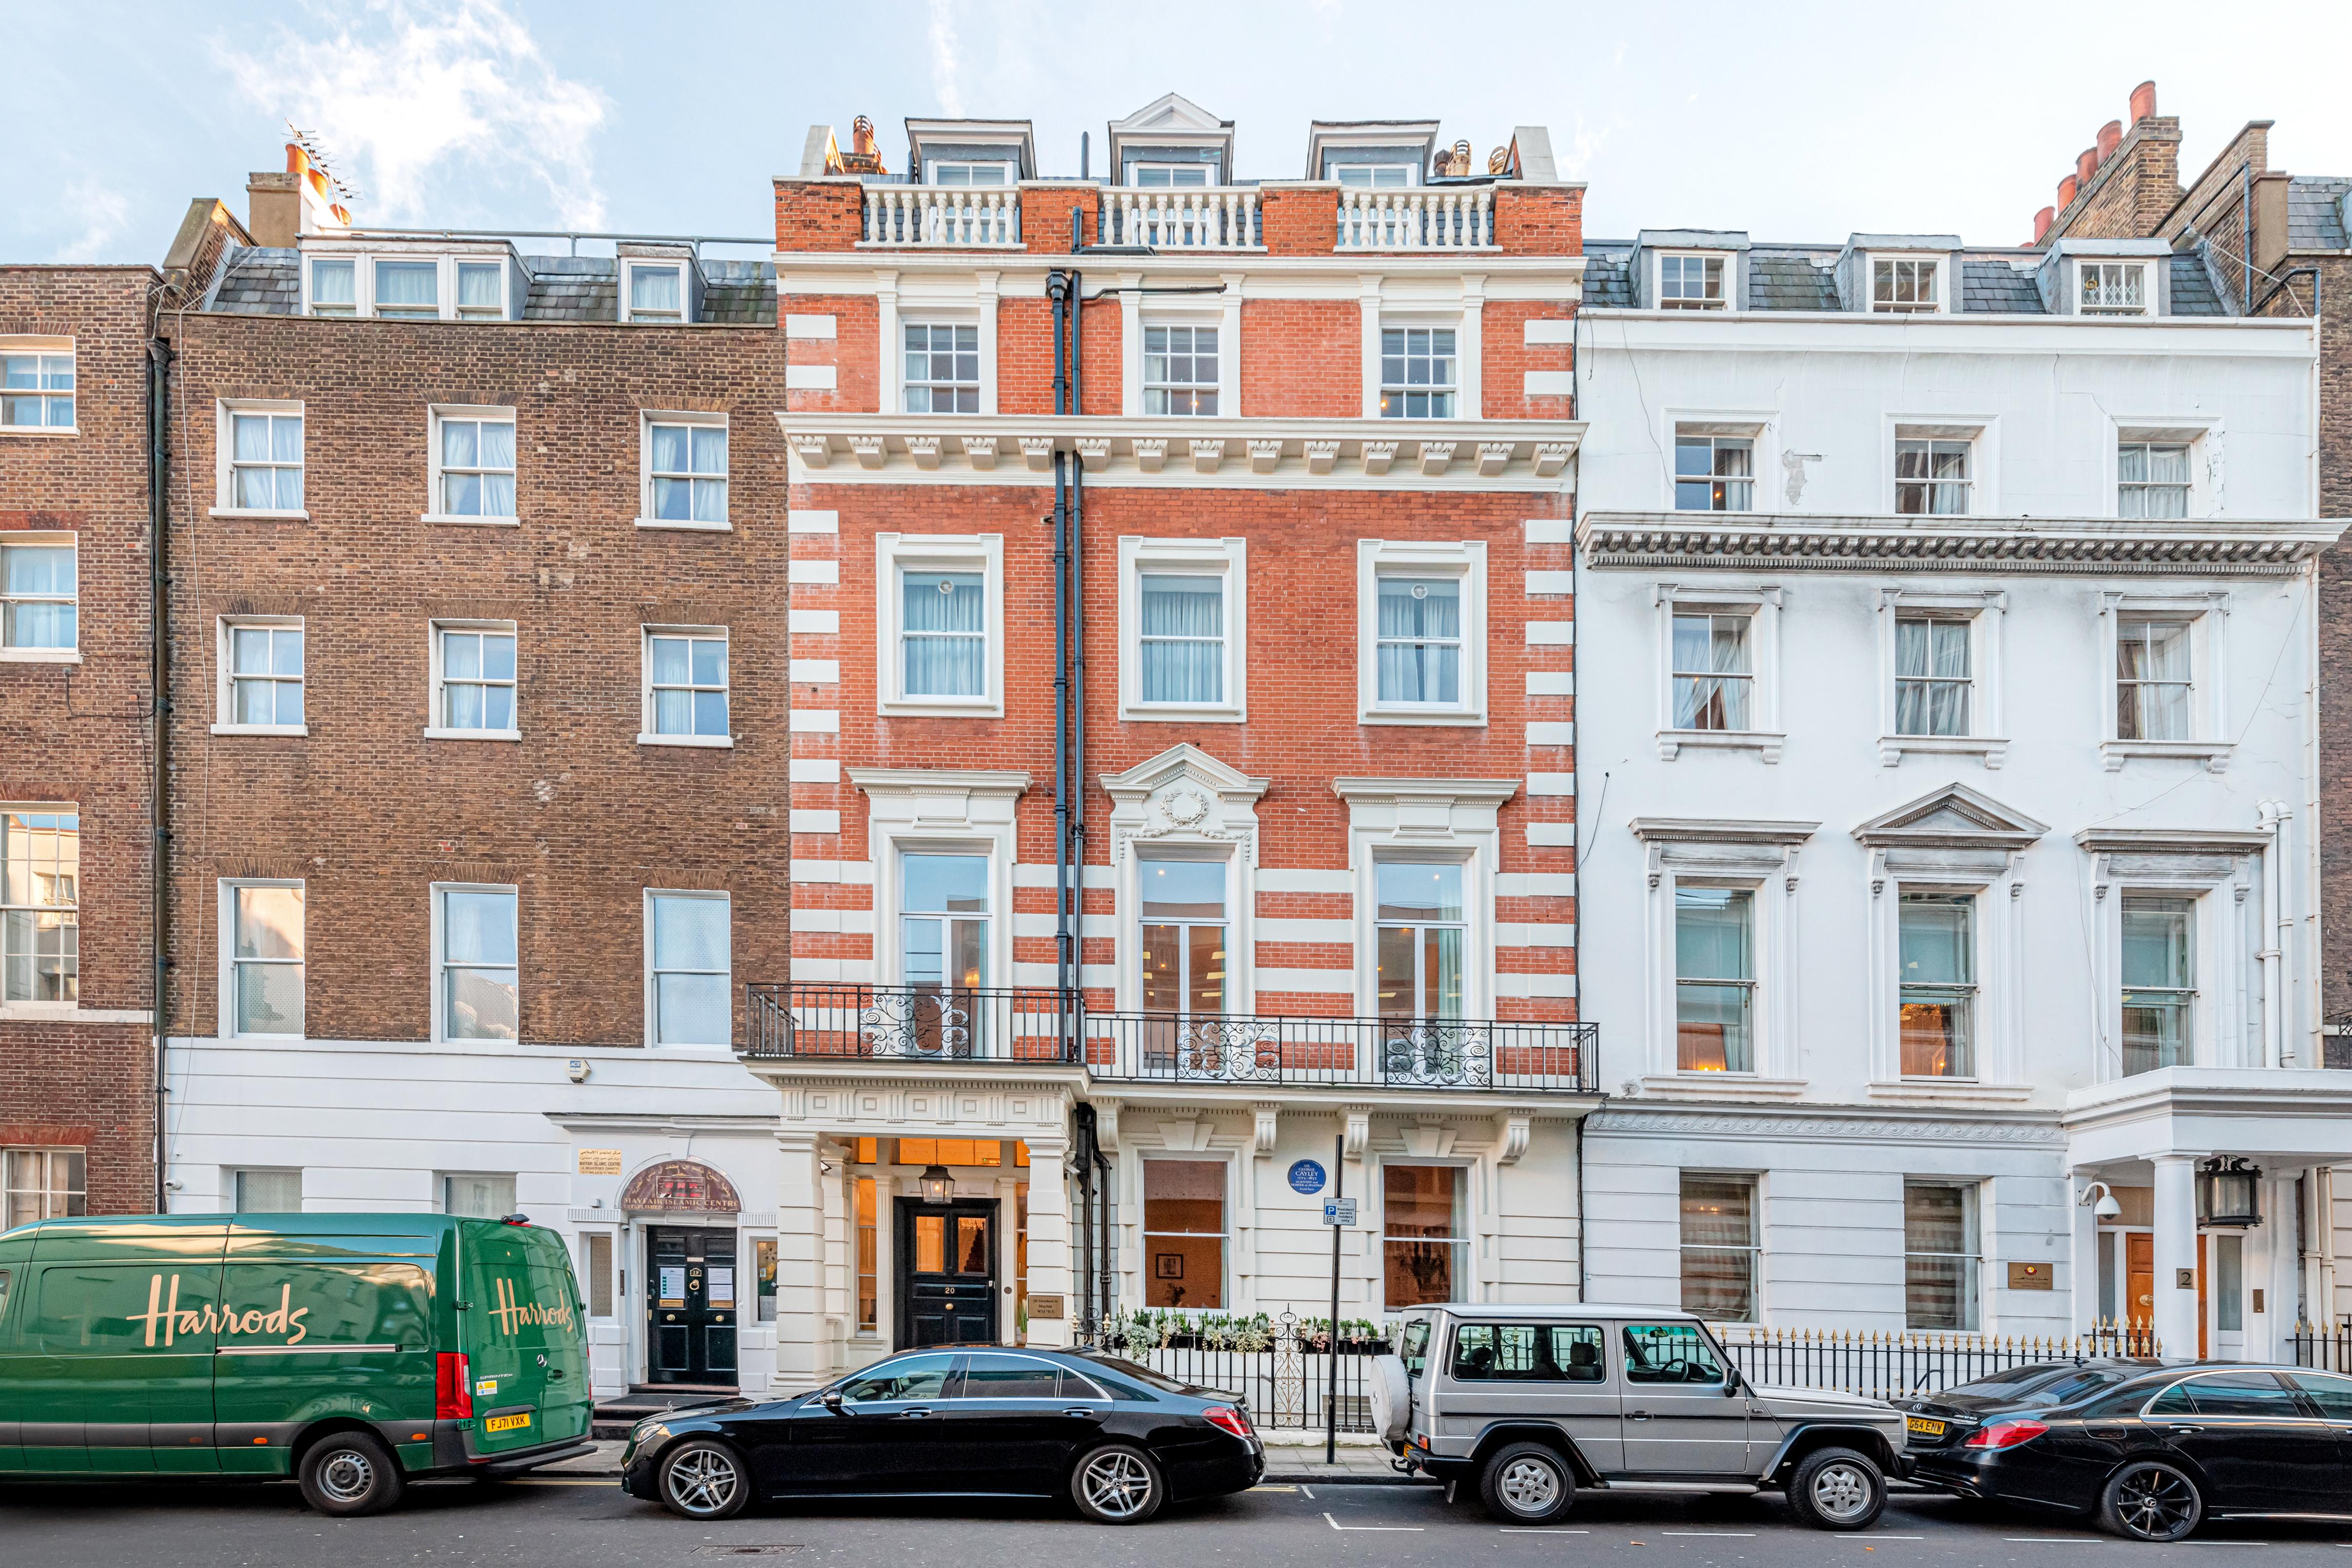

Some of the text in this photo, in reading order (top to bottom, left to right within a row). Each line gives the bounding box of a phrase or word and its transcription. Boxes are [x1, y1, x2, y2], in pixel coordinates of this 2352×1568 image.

[126, 1274, 308, 1347] Harrods
[488, 1277, 573, 1335] Harrods
[491, 1416, 525, 1429] FJ71 VXK
[1907, 1420, 1942, 1432] G64 ENW
